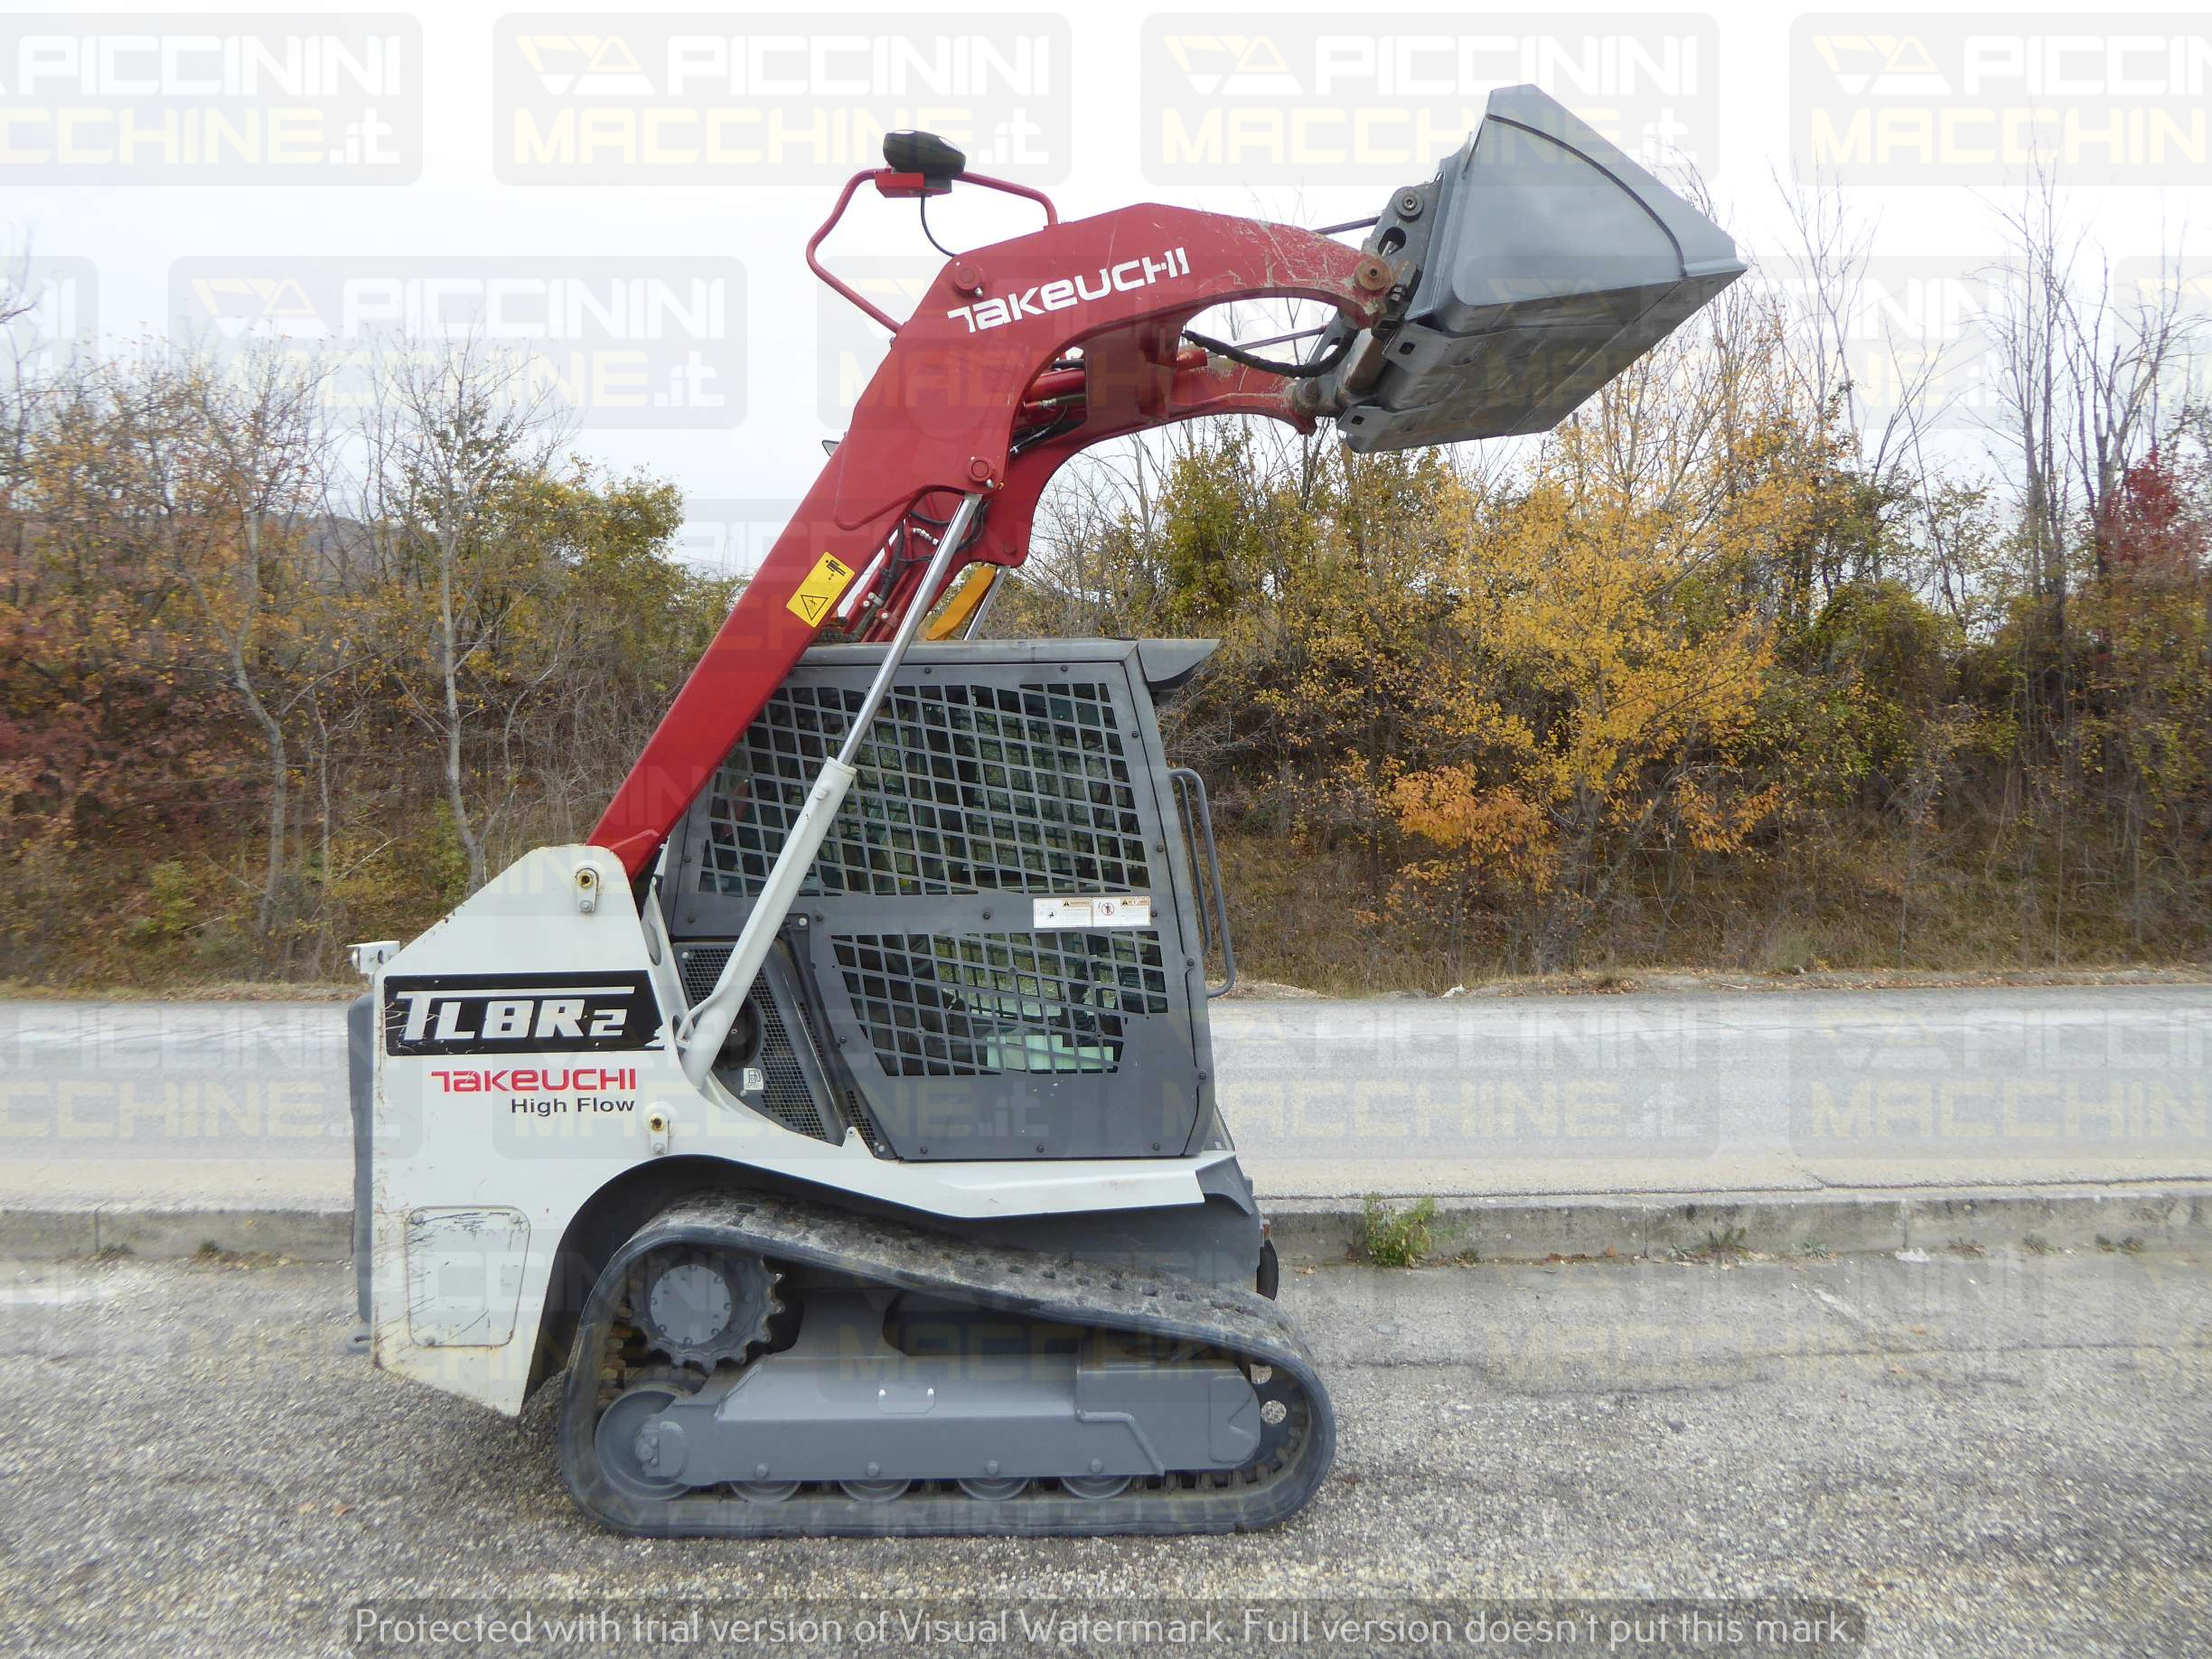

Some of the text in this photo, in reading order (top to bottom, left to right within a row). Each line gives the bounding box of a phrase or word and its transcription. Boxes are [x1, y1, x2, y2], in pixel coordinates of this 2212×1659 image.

[431, 1068, 636, 1092] TAKEUCHI
[511, 1097, 635, 1117] High Flow
